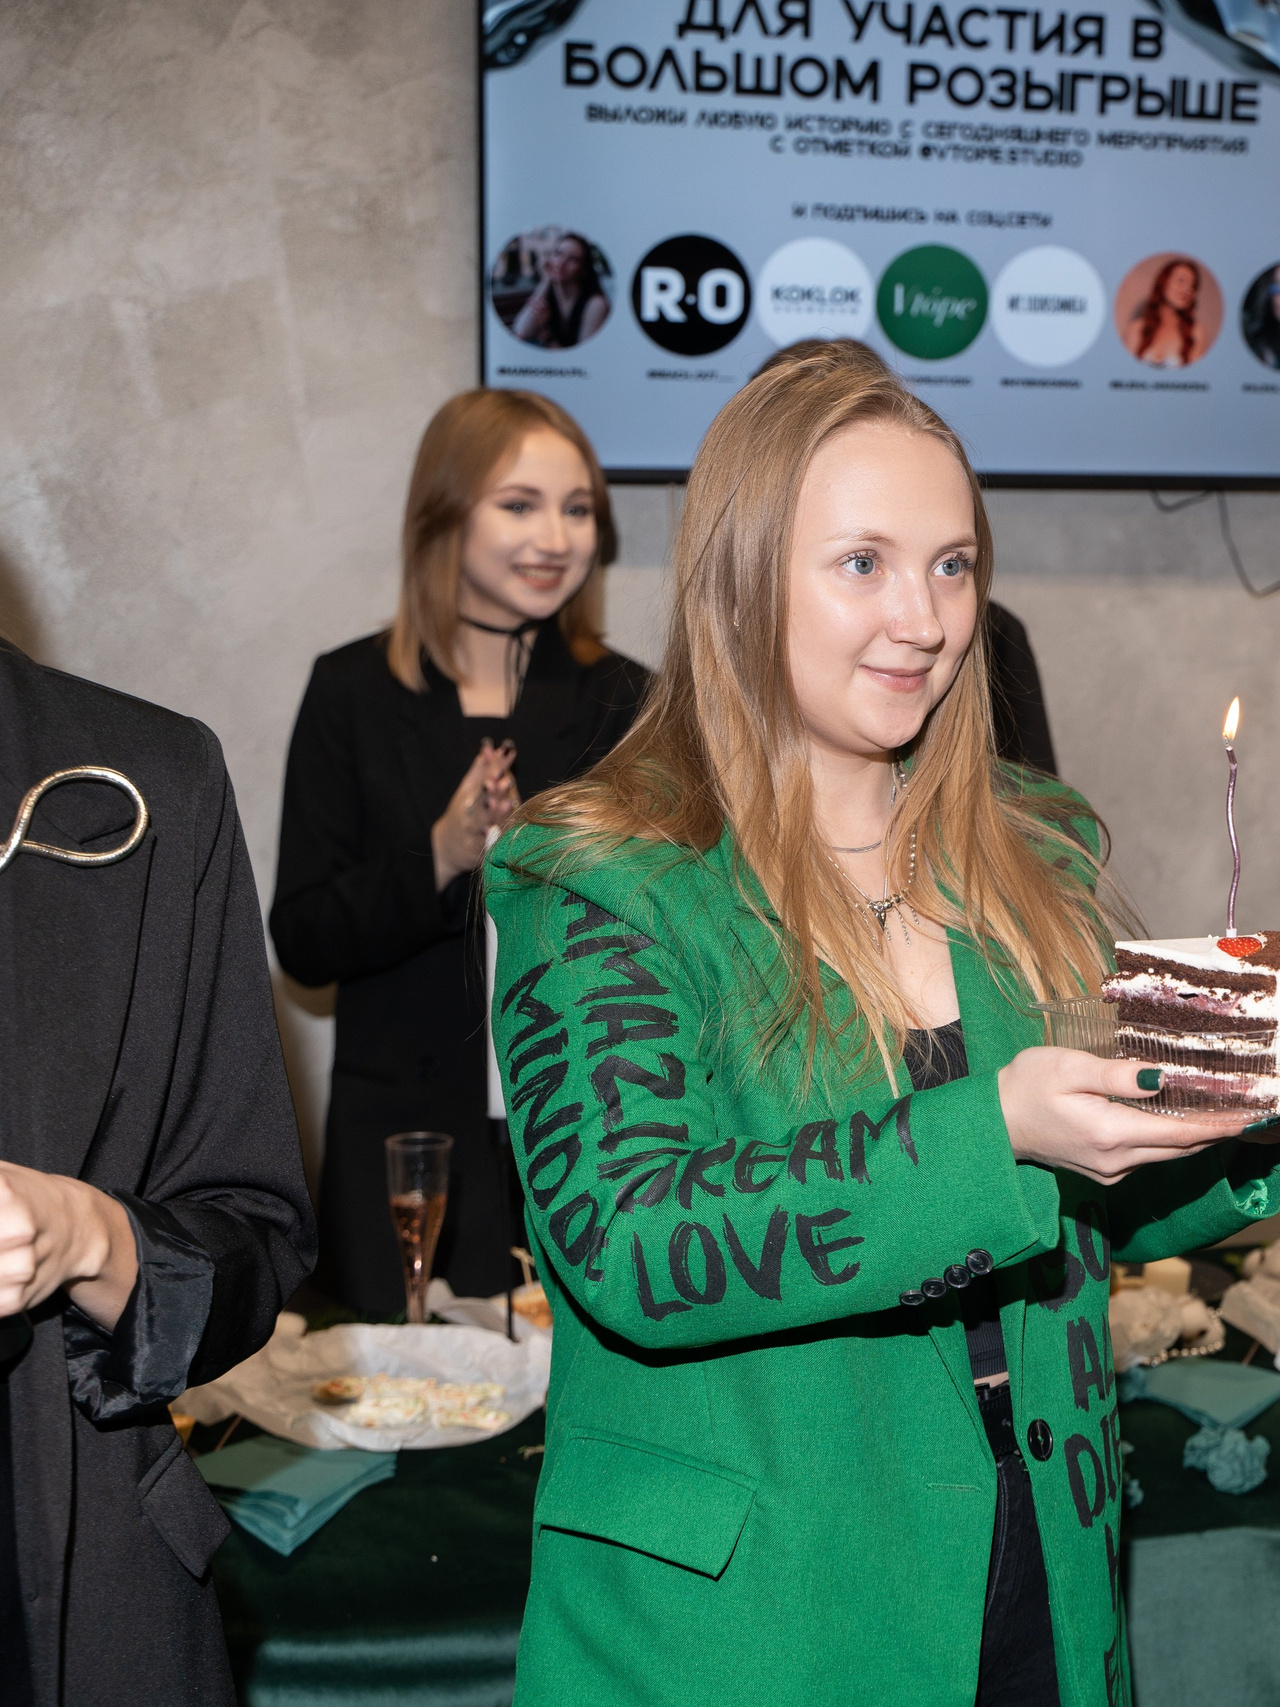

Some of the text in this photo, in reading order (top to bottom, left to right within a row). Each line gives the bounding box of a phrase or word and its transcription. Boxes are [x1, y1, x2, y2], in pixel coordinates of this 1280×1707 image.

[676, 0, 1164, 59] ДЛЯ УЧАСТИЯ В
[564, 42, 1260, 123] БОЛЬШОМ РОЗЫГРЫШЕ
[784, 113, 892, 137] ИСТОРИЮ
[631, 1204, 866, 1322] LOVE
